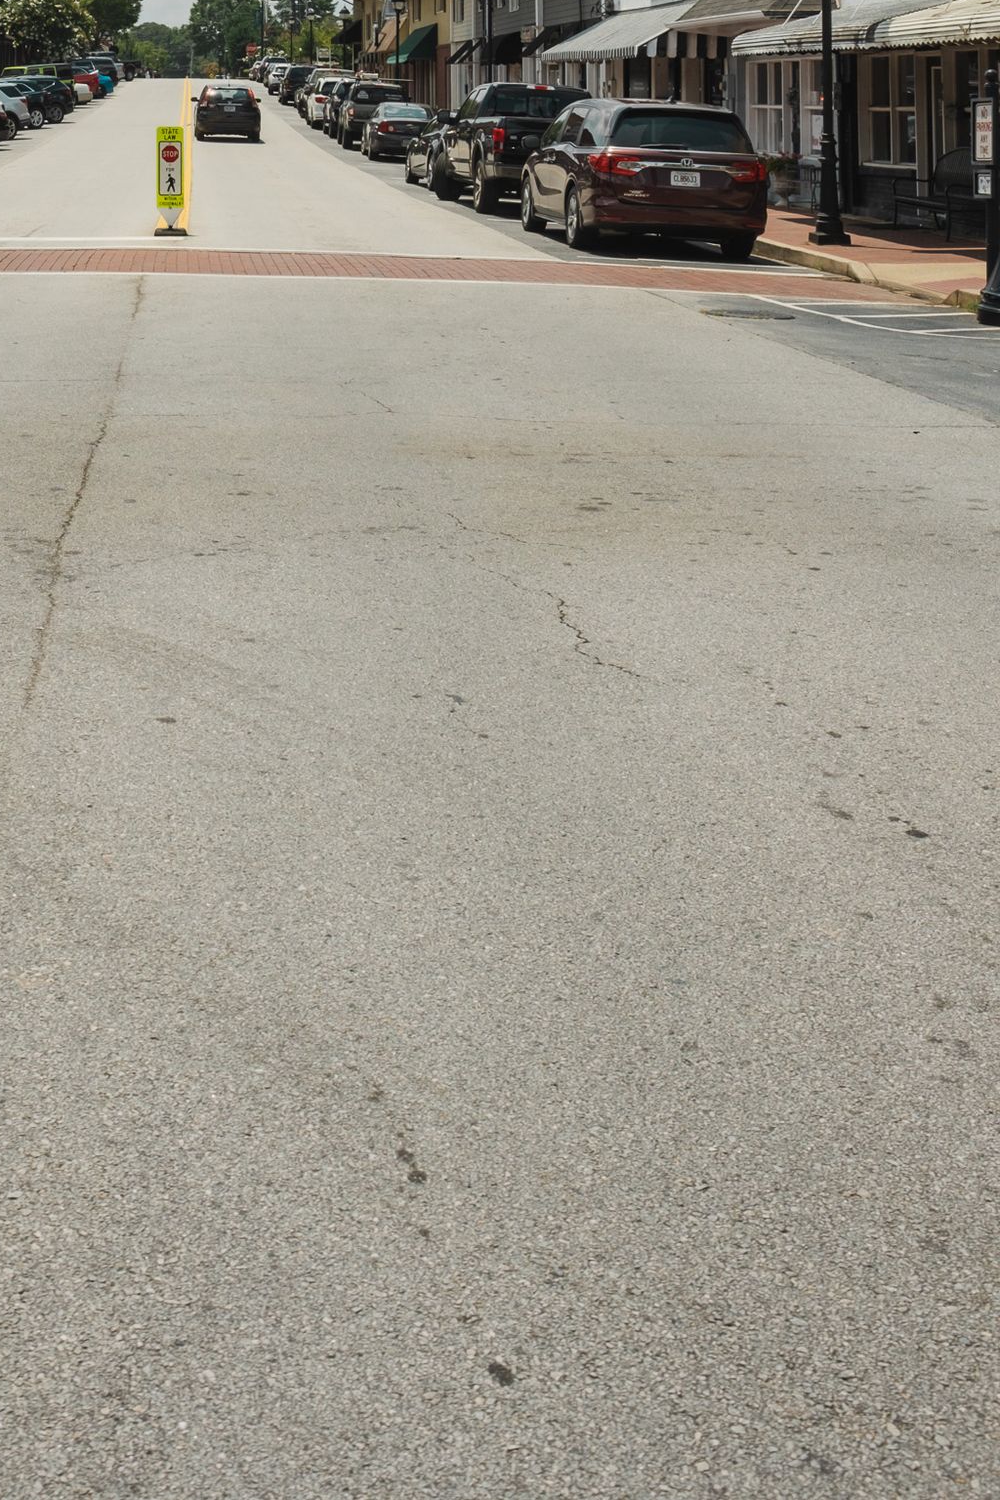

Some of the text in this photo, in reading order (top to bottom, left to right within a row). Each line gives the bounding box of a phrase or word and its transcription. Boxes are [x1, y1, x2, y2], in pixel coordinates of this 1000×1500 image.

[976, 122, 992, 131] PARKING
[980, 134, 988, 143] ANY
[980, 145, 988, 155] TIME
